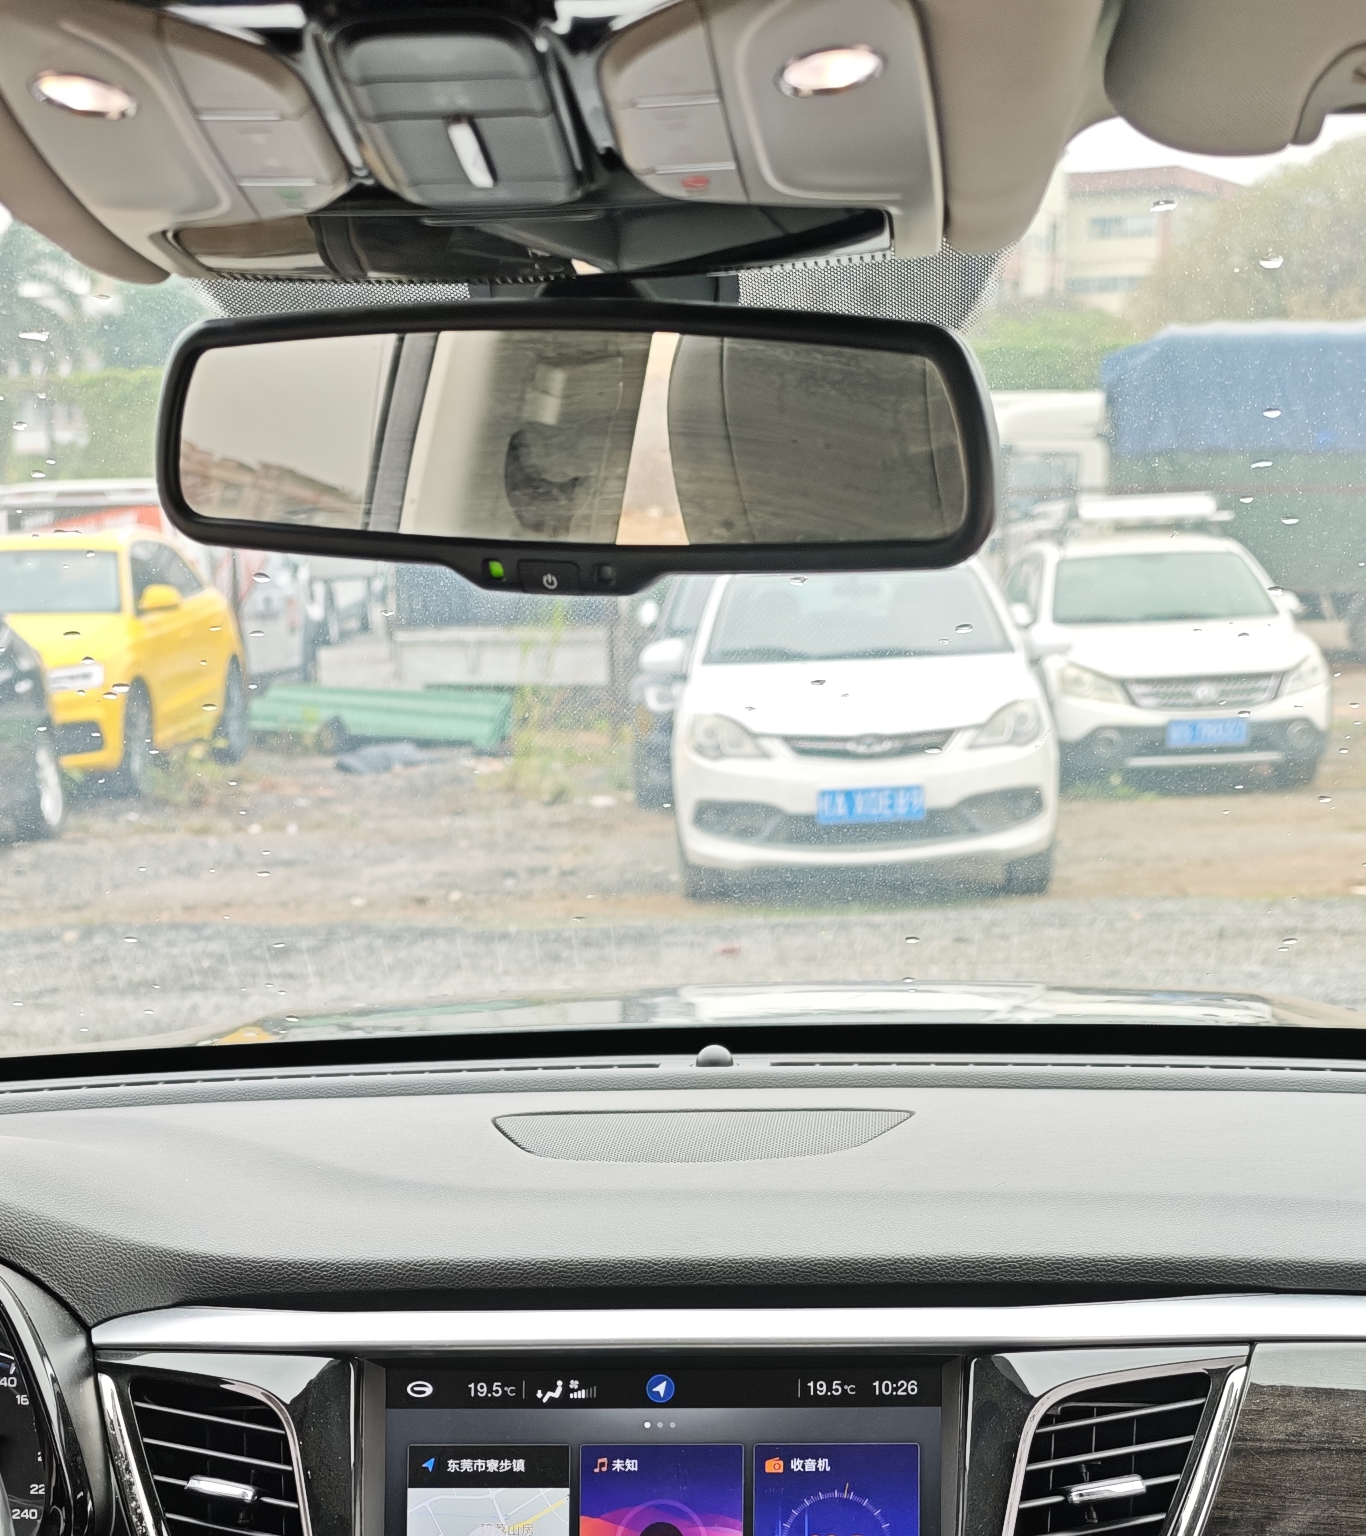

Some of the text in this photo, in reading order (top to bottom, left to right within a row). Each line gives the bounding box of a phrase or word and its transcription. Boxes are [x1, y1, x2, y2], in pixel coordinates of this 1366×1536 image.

[872, 1380, 918, 1396] 10:26
[16, 1394, 29, 1406] 16
[446, 1459, 526, 1473] 东莞市寮步镇
[611, 1458, 638, 1473] 未知
[790, 1457, 831, 1473] 收音机
[29, 1483, 46, 1496] 22
[11, 1508, 38, 1520] 240
